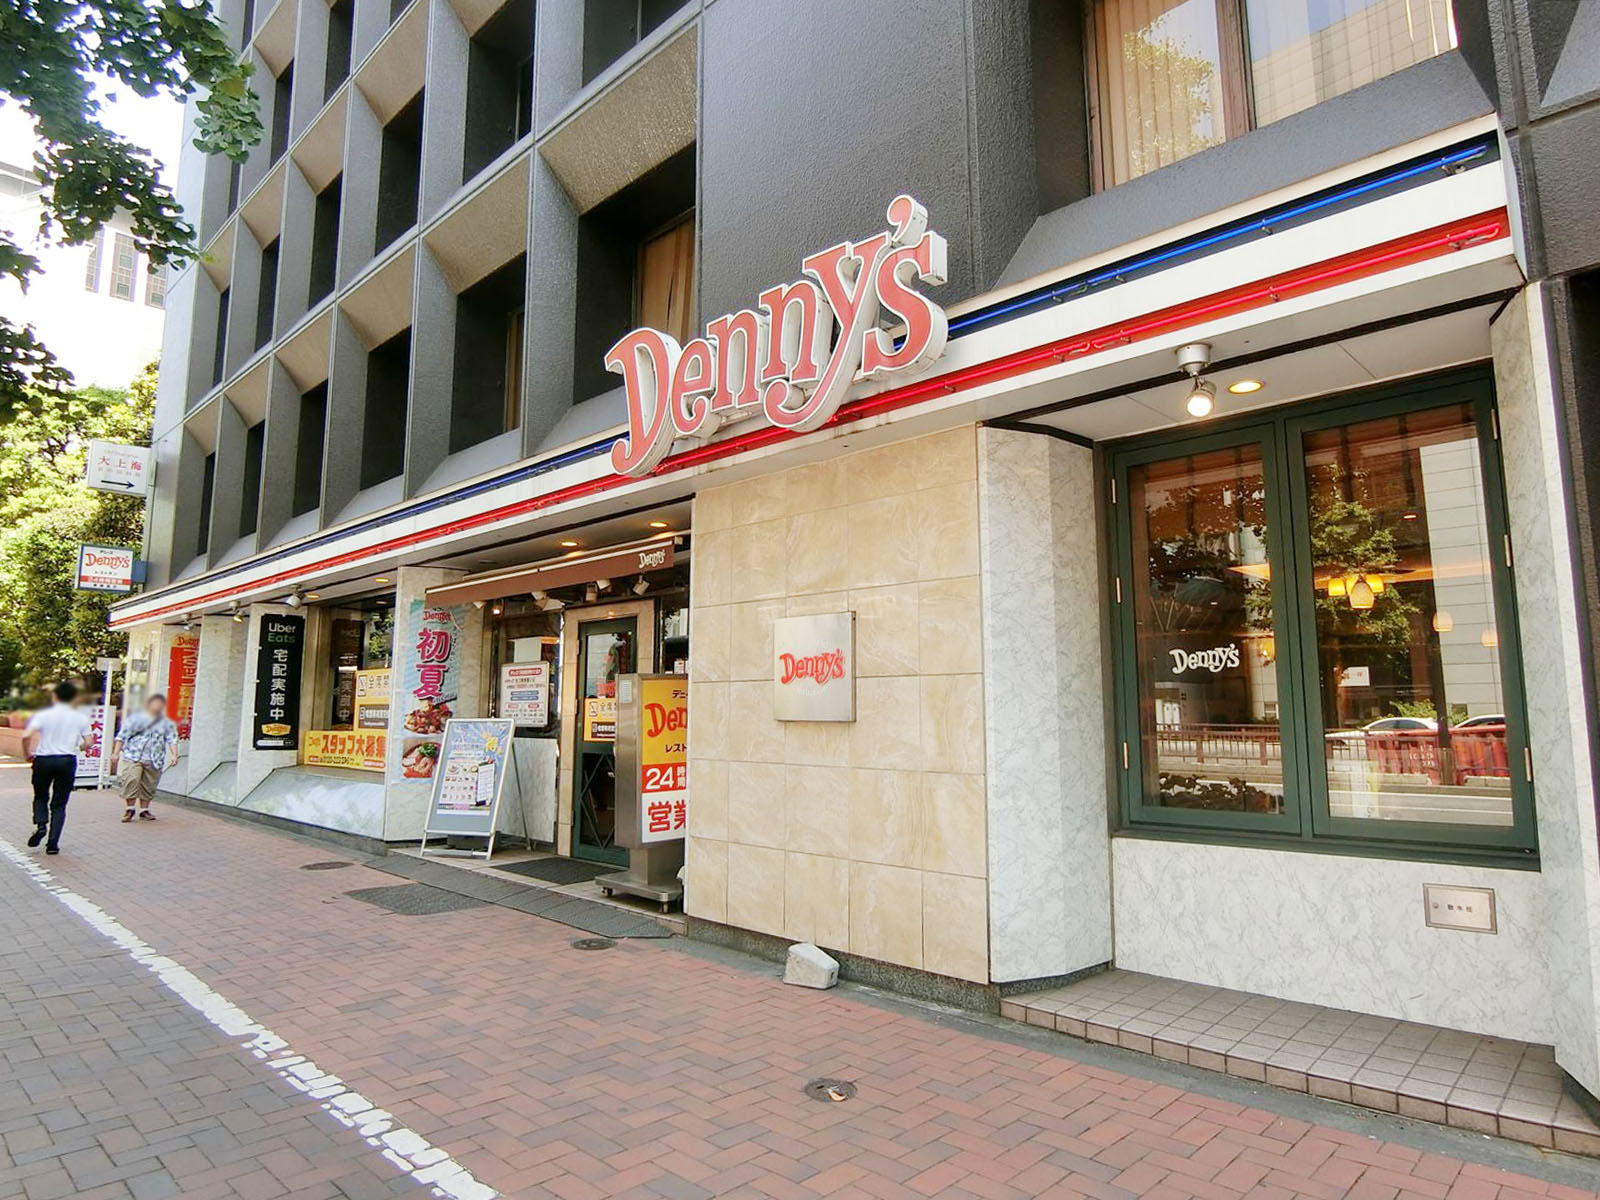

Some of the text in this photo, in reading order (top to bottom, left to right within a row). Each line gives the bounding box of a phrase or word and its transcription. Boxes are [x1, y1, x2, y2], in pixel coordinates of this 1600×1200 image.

[604, 194, 948, 477] Denny's
[99, 456, 143, 471] 大上海
[85, 553, 130, 570] Denny's
[638, 549, 666, 569] Denny's
[267, 632, 296, 643] Eats
[268, 622, 297, 633] Uber
[413, 627, 451, 699] 初夏
[779, 648, 846, 685] Denny's
[1168, 643, 1240, 674] Denny's
[270, 648, 288, 721] 宅配実施中
